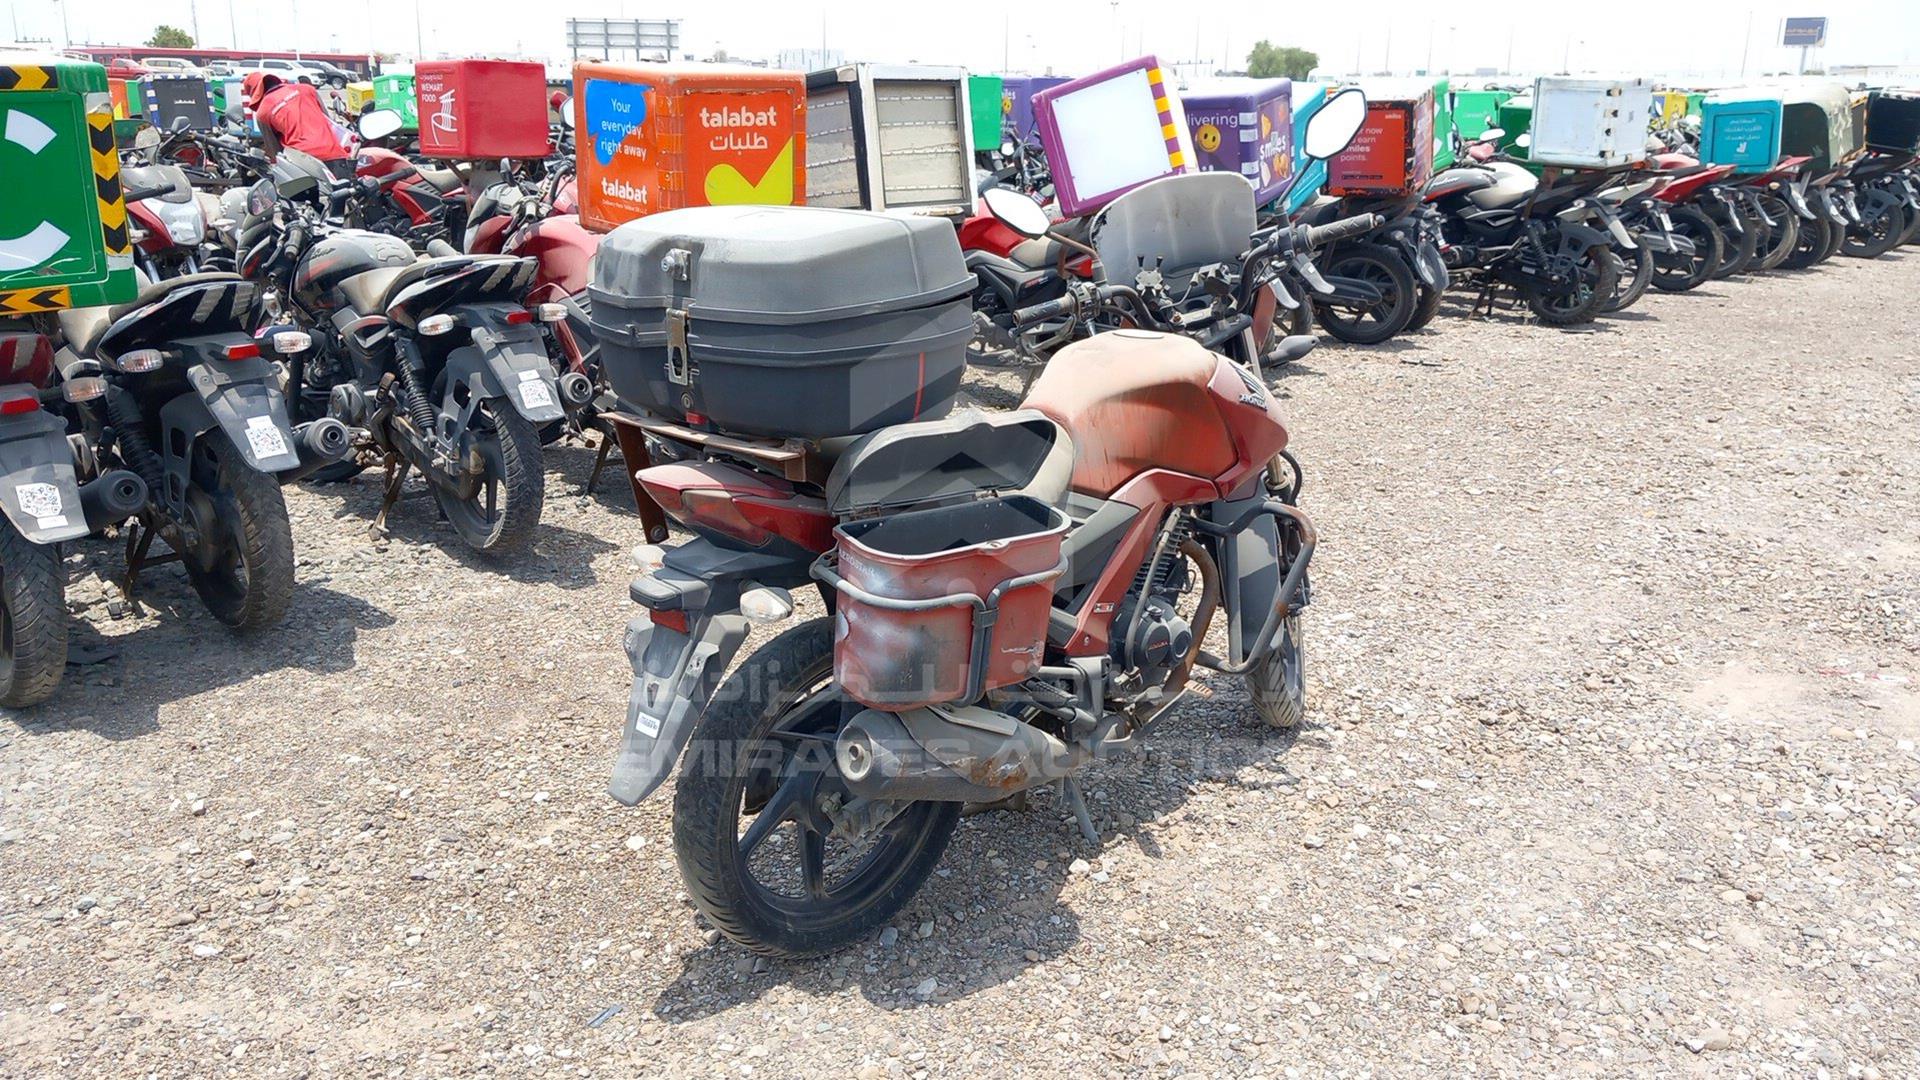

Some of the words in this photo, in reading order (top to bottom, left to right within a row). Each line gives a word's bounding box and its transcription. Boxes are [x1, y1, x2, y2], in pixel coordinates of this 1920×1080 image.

[421, 83, 444, 92] WEMART
[421, 93, 437, 102] FOOD
[610, 98, 631, 113] Your
[699, 105, 777, 128] talabat
[601, 120, 644, 140] everyday,
[1366, 127, 1384, 135] now
[709, 132, 768, 155] طلبات
[1357, 136, 1377, 144] earn
[601, 138, 622, 156] right
[623, 144, 647, 161] away
[1345, 144, 1371, 153] miles
[601, 177, 648, 204] talabat
